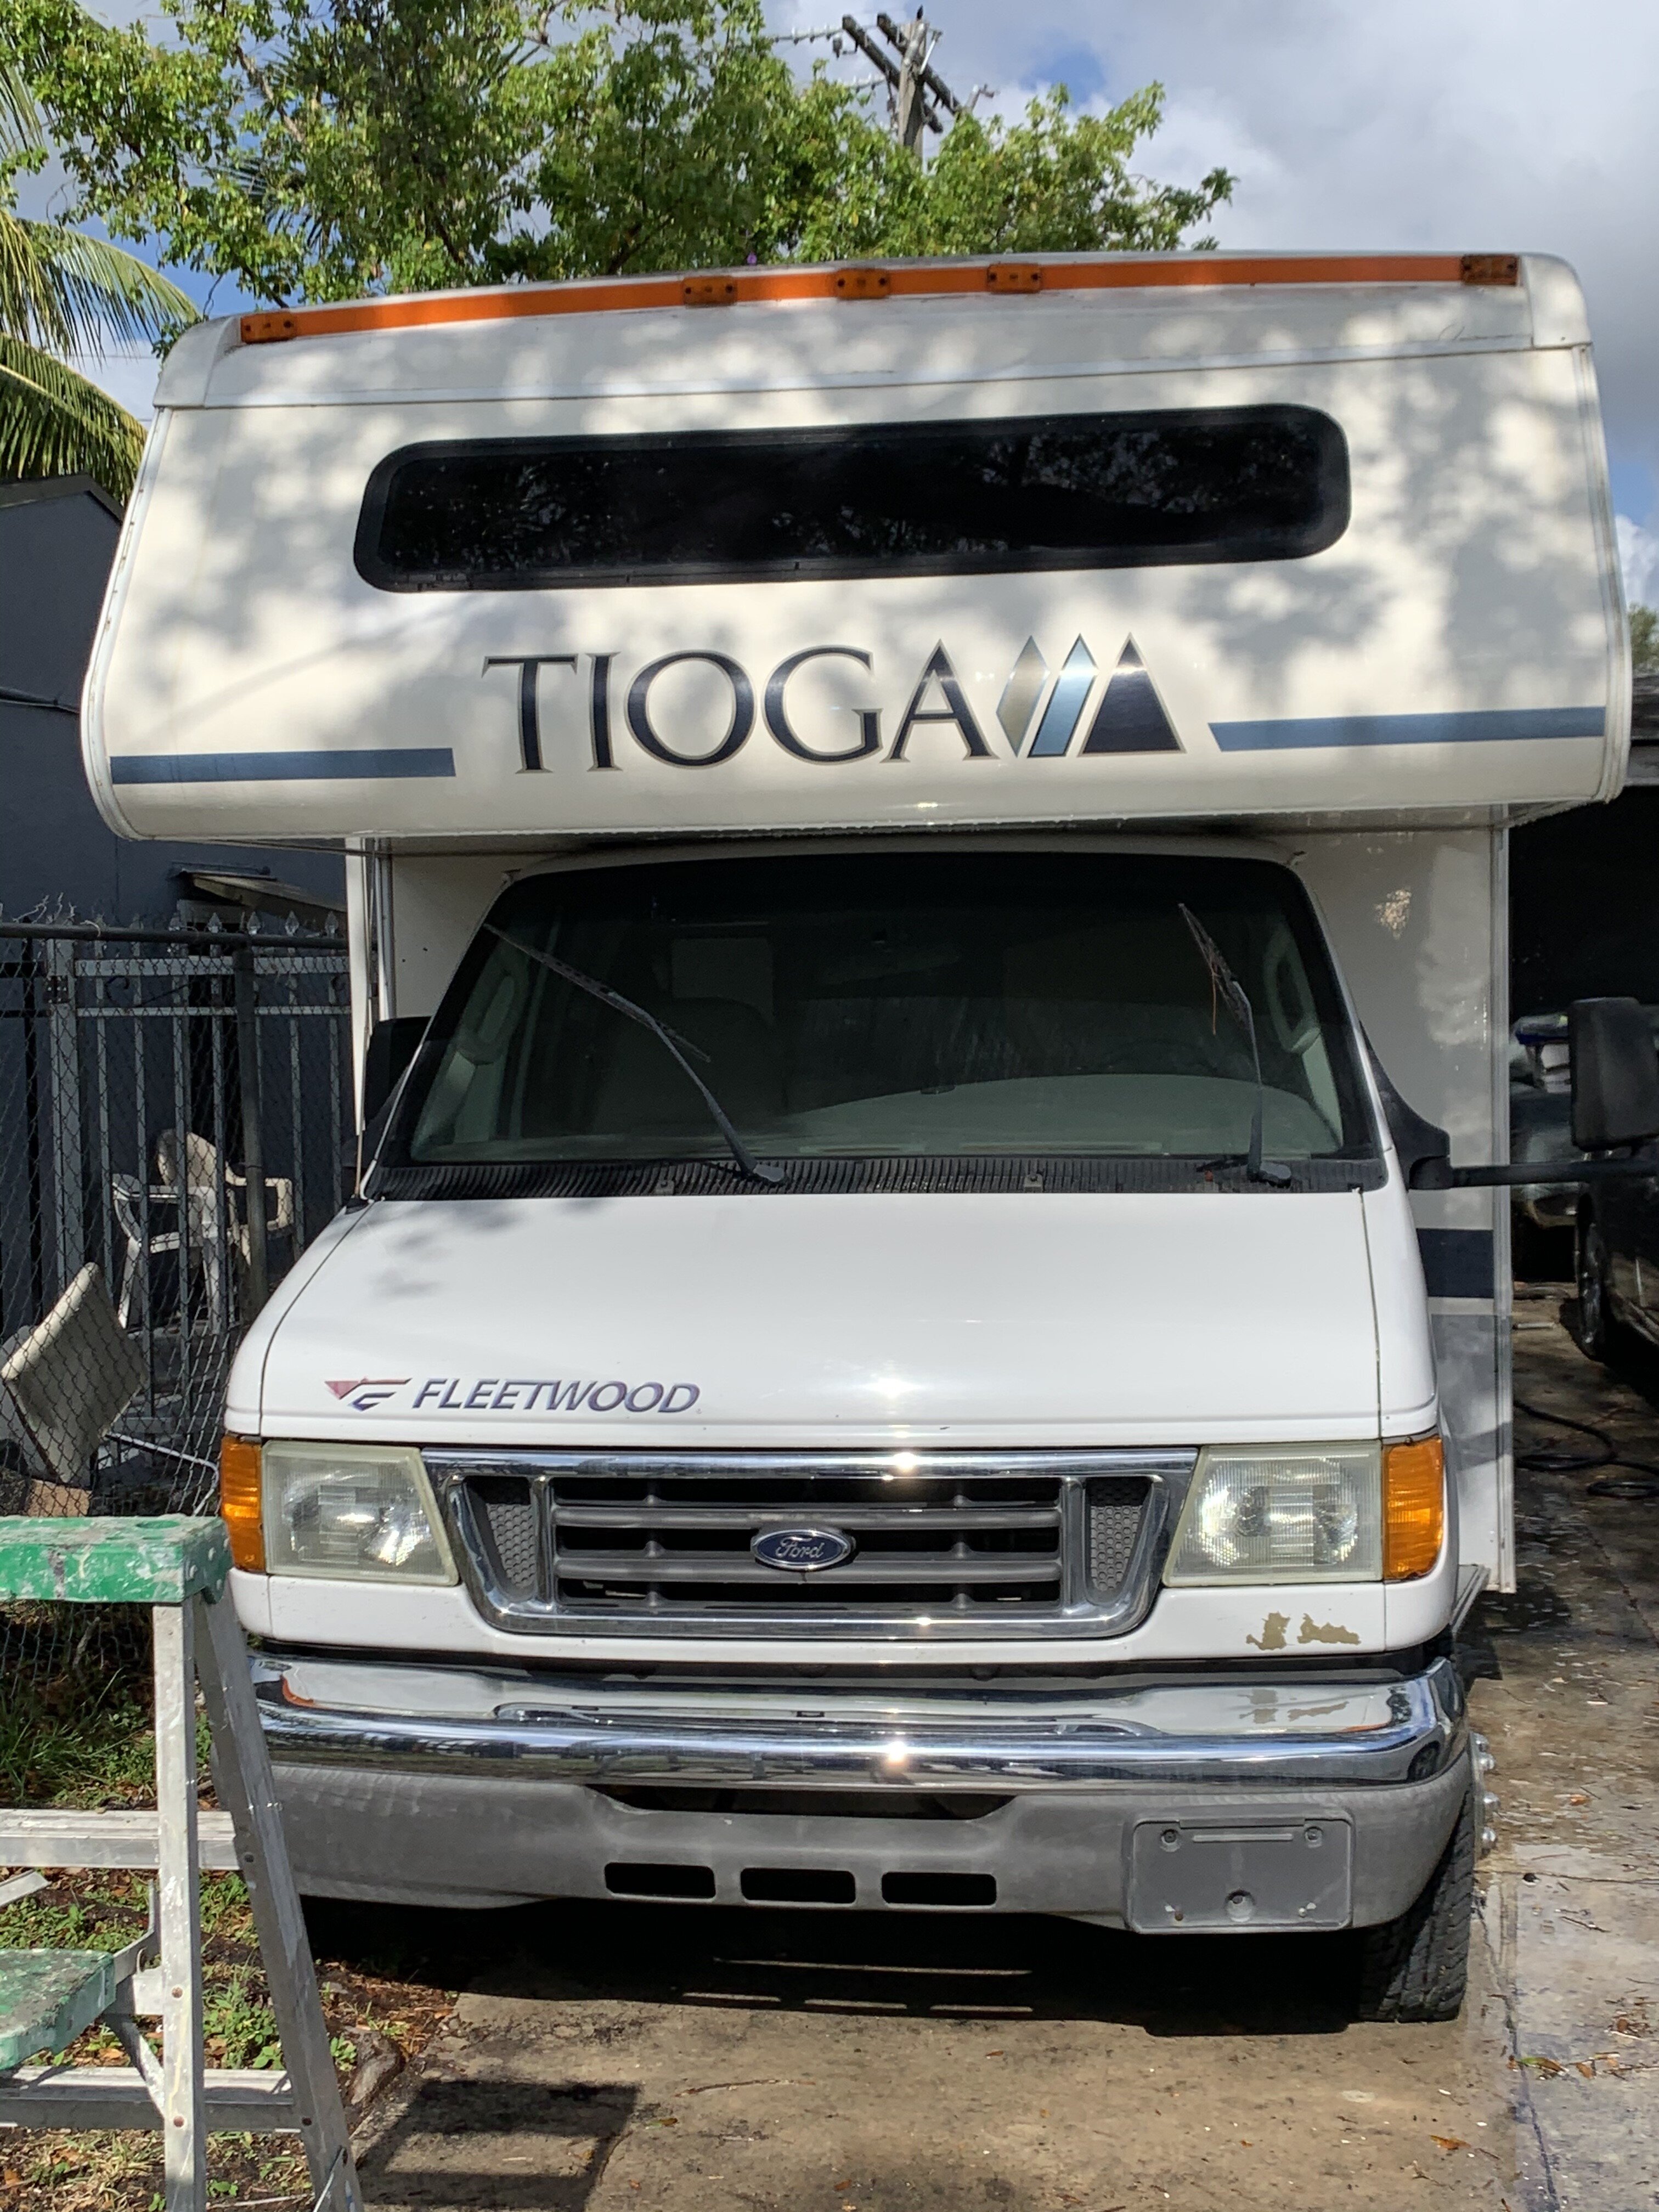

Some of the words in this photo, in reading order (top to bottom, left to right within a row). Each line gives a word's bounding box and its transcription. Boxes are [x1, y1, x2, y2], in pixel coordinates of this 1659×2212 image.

[481, 638, 1000, 774] TIOGA
[412, 1378, 700, 1413] FLEETWOOD
[776, 1536, 825, 1558] Ford
